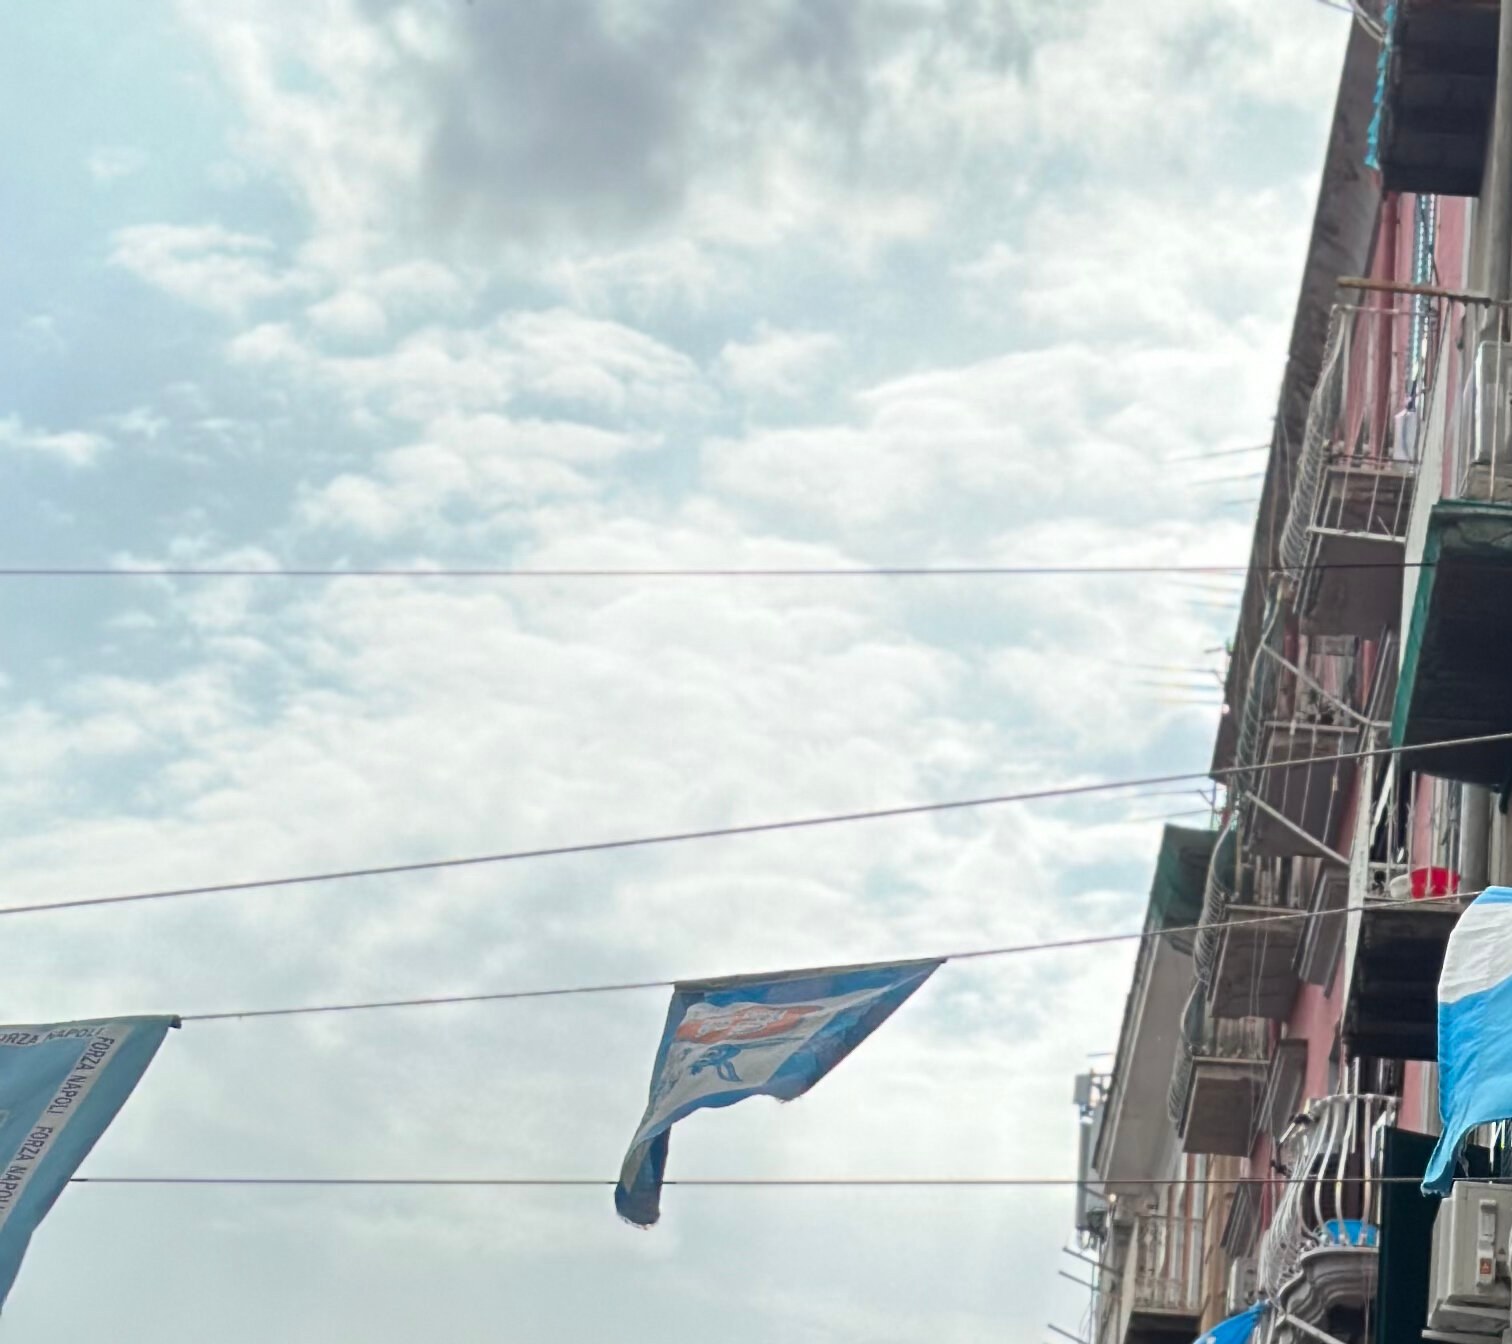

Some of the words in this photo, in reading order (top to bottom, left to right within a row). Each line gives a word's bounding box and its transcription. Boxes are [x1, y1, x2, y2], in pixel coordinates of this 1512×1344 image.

[75, 1036, 115, 1071] FORZA
[47, 1072, 88, 1115] NAPOLI
[16, 1125, 54, 1161] FORZA
[0, 1165, 28, 1210] NAPO
